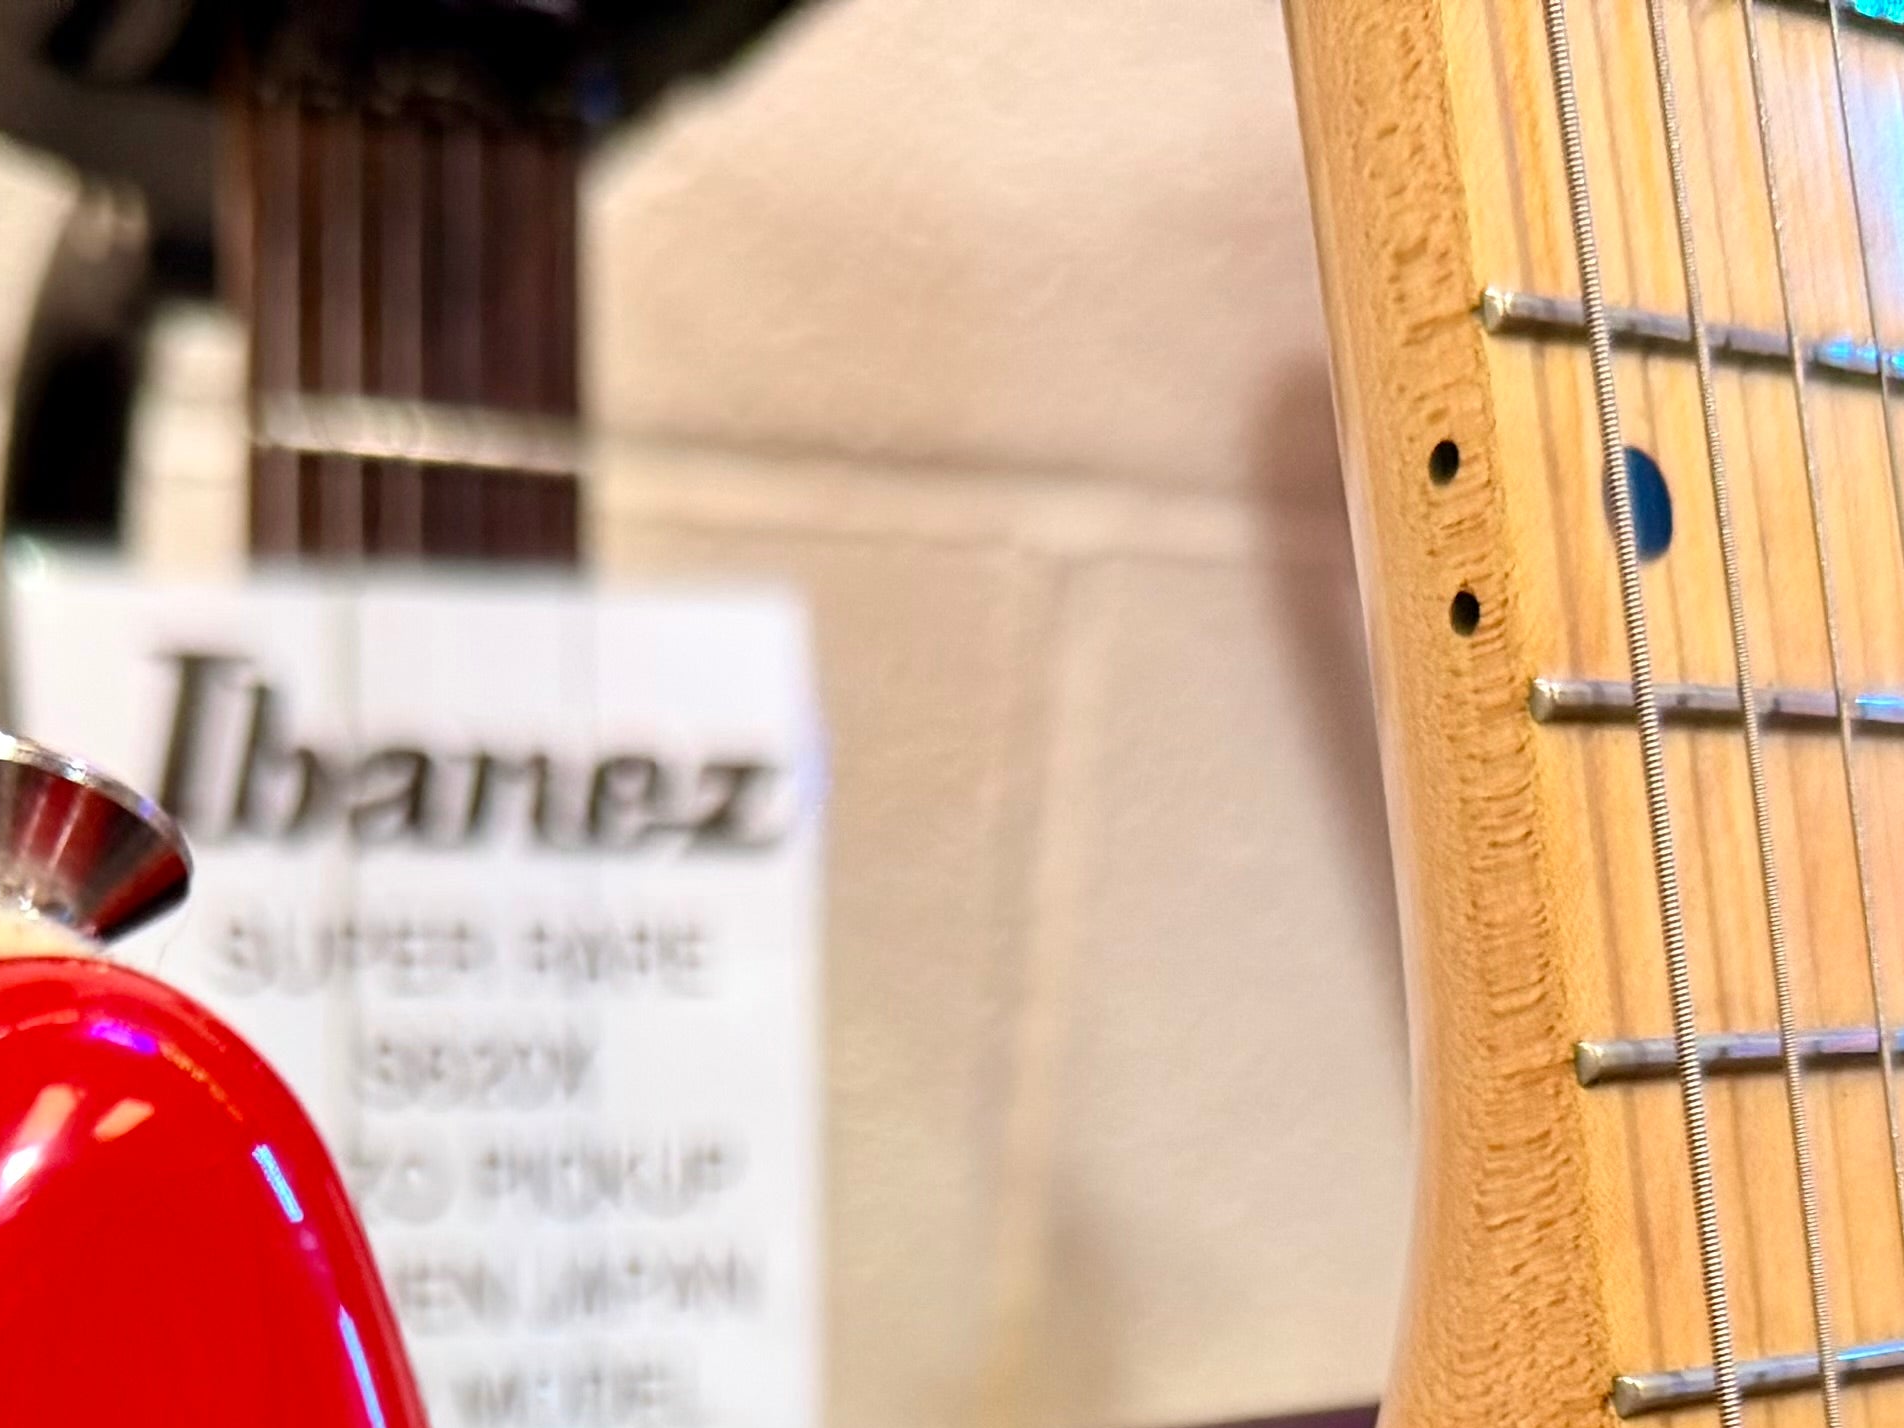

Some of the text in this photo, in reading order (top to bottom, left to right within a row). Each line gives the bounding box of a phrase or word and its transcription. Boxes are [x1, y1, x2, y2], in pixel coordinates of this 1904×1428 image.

[152, 648, 788, 856] Ibanez
[210, 908, 716, 988] SUPER RARE
[470, 1132, 741, 1216] PICKUP
[532, 1241, 757, 1323] JAPAN
